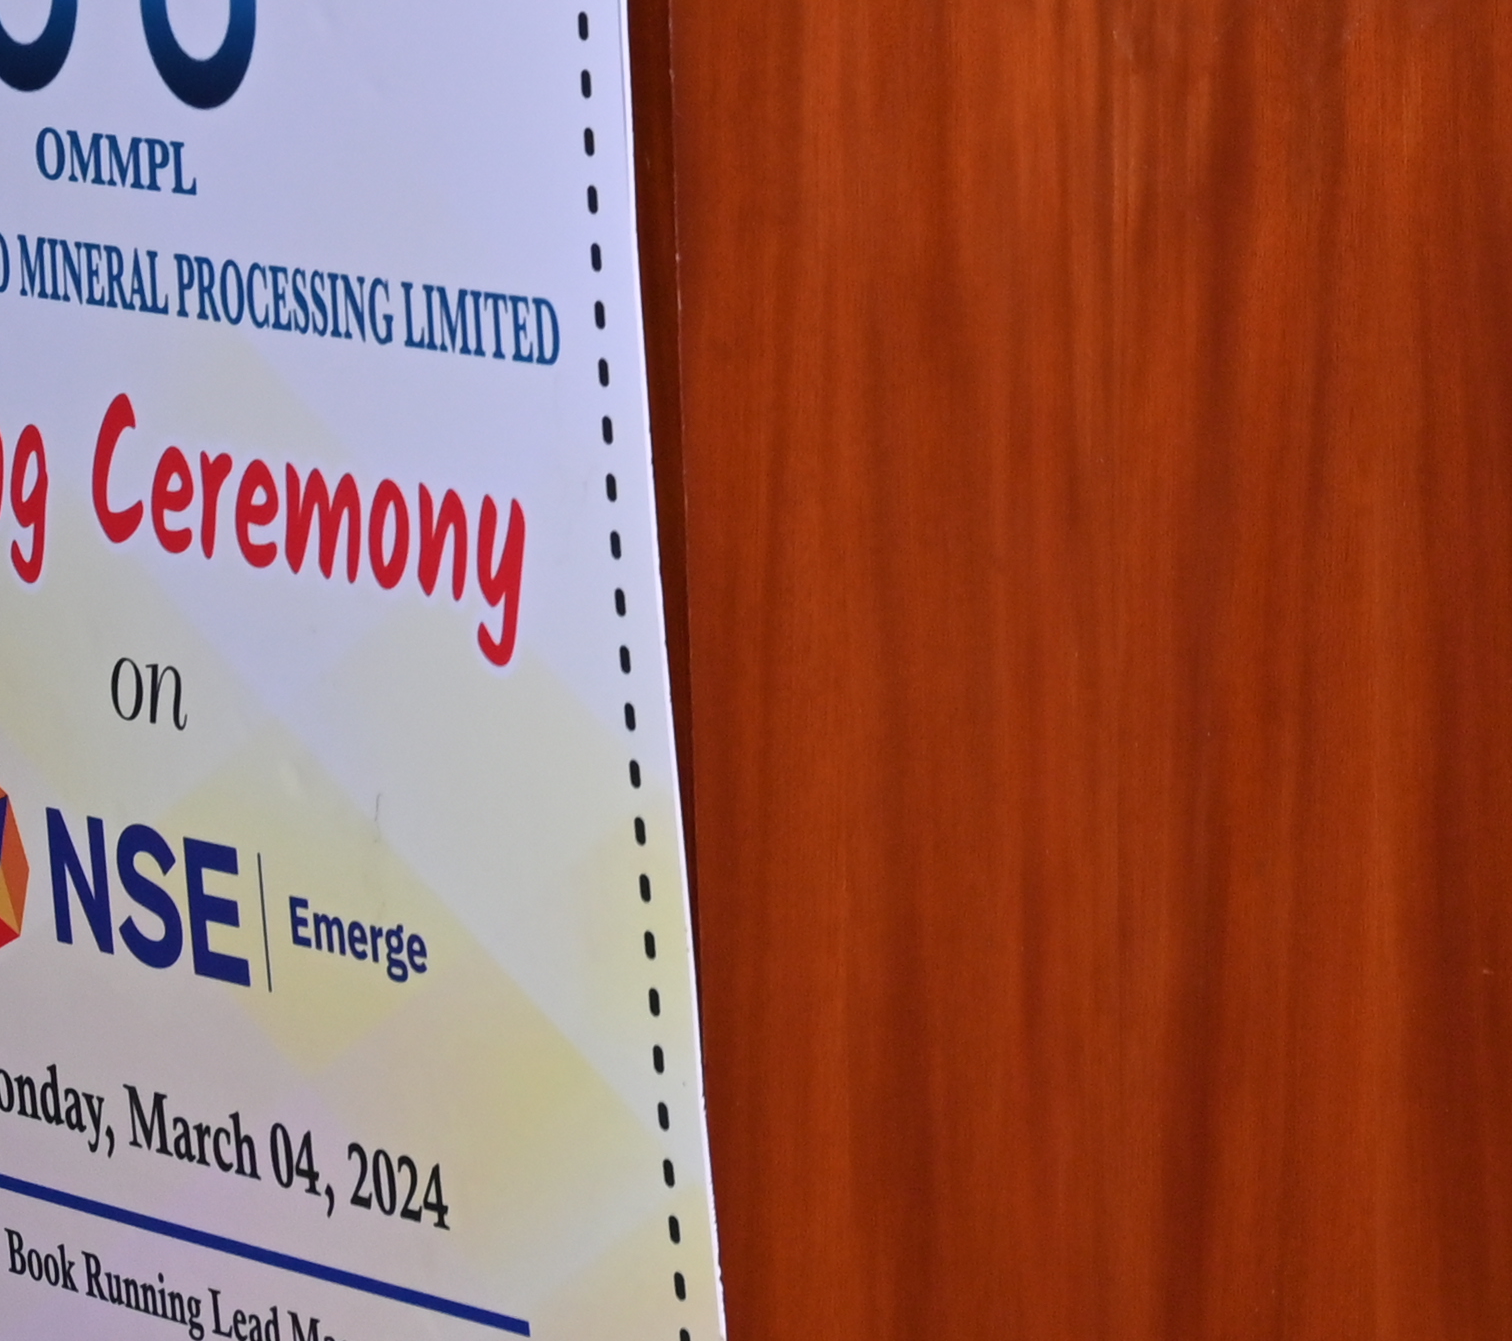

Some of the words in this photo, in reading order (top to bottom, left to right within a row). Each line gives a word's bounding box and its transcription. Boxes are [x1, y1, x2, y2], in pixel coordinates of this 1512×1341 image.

[36, 127, 196, 195] OMMPL
[18, 235, 168, 315] MINERAL
[174, 254, 393, 344] PROCESSING
[401, 282, 559, 365] LIMITED
[92, 394, 525, 666] Ceremony
[111, 658, 187, 730] on
[46, 807, 250, 986] NSE
[289, 896, 427, 982] Emerge
[123, 1084, 261, 1180] March
[270, 1123, 334, 1217] 04,
[348, 1143, 449, 1230] 2024
[5, 1228, 78, 1292] Book
[82, 1251, 204, 1341] Running
[208, 1288, 280, 1341] Lead
